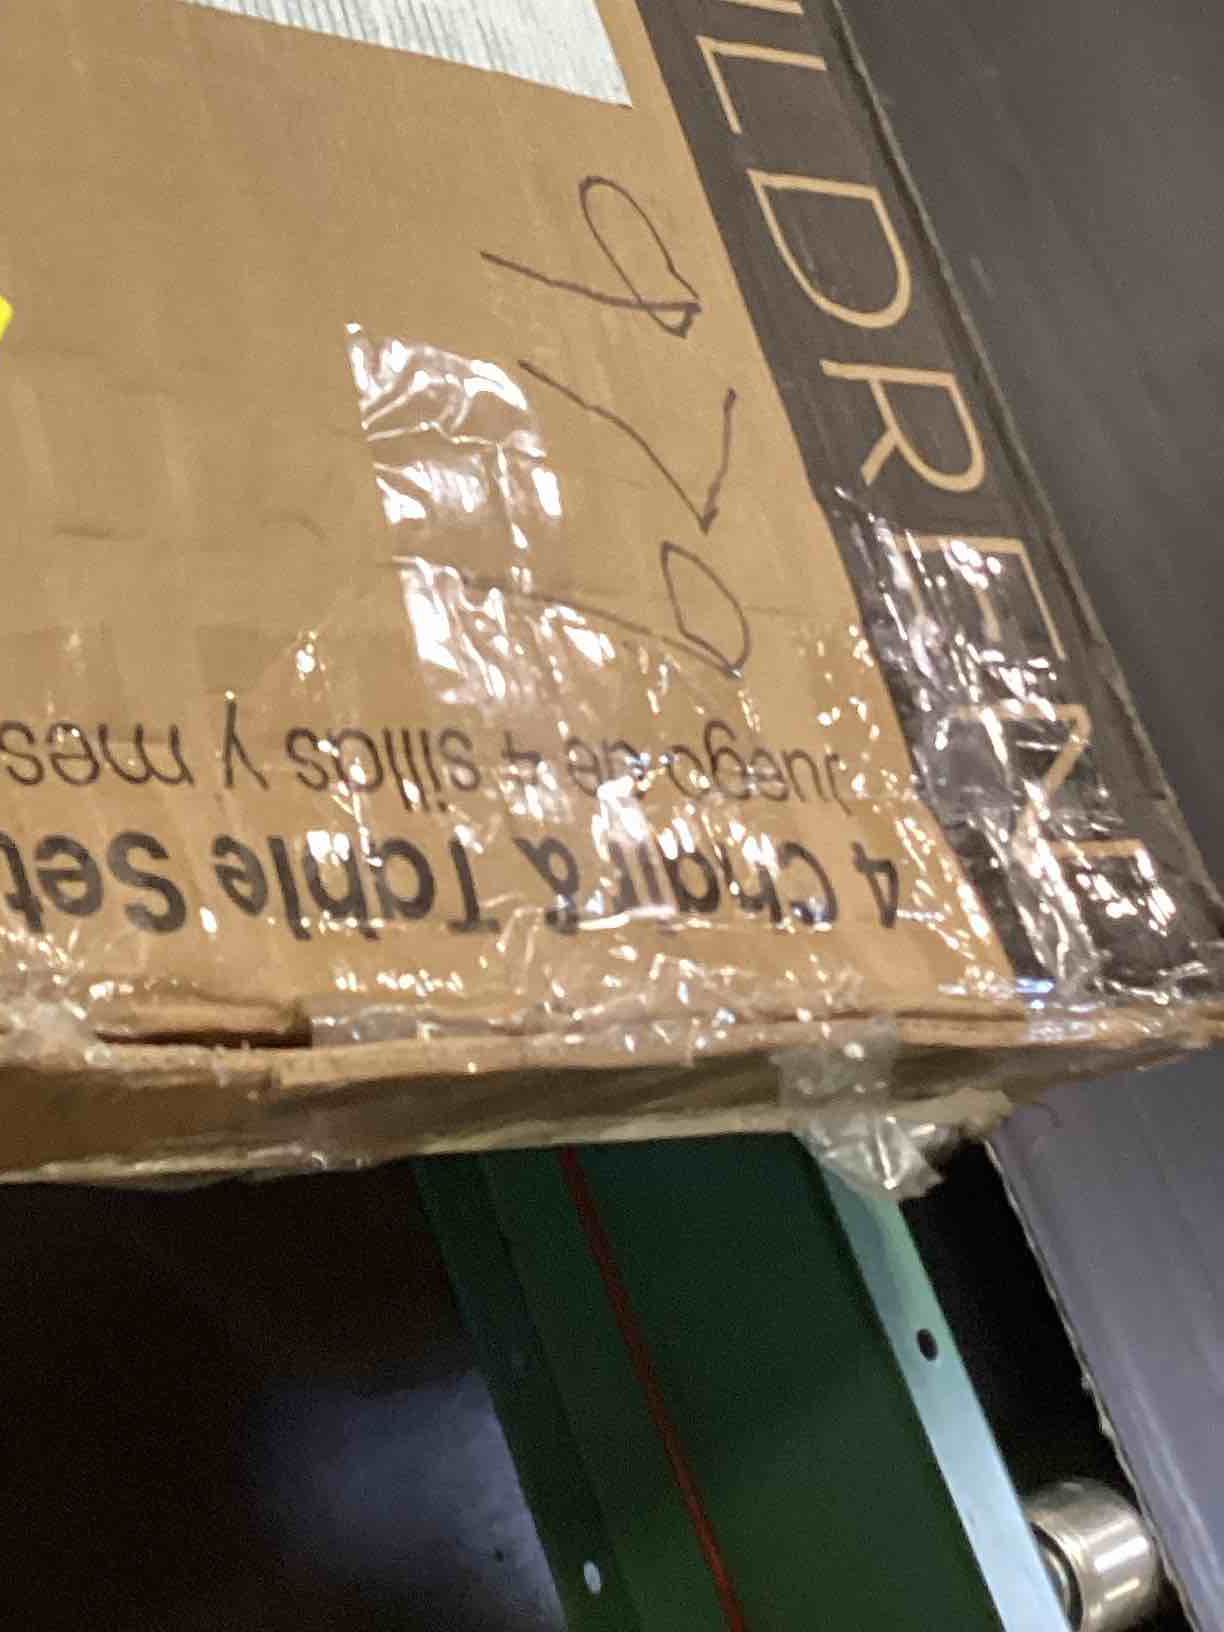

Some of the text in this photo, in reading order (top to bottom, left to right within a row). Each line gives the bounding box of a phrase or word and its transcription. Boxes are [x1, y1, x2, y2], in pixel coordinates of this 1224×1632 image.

[219, 699, 266, 800] y
[286, 725, 484, 815] sillas
[211, 834, 500, 941] Table
[588, 834, 839, 932] Chair
[849, 838, 904, 931] 4
